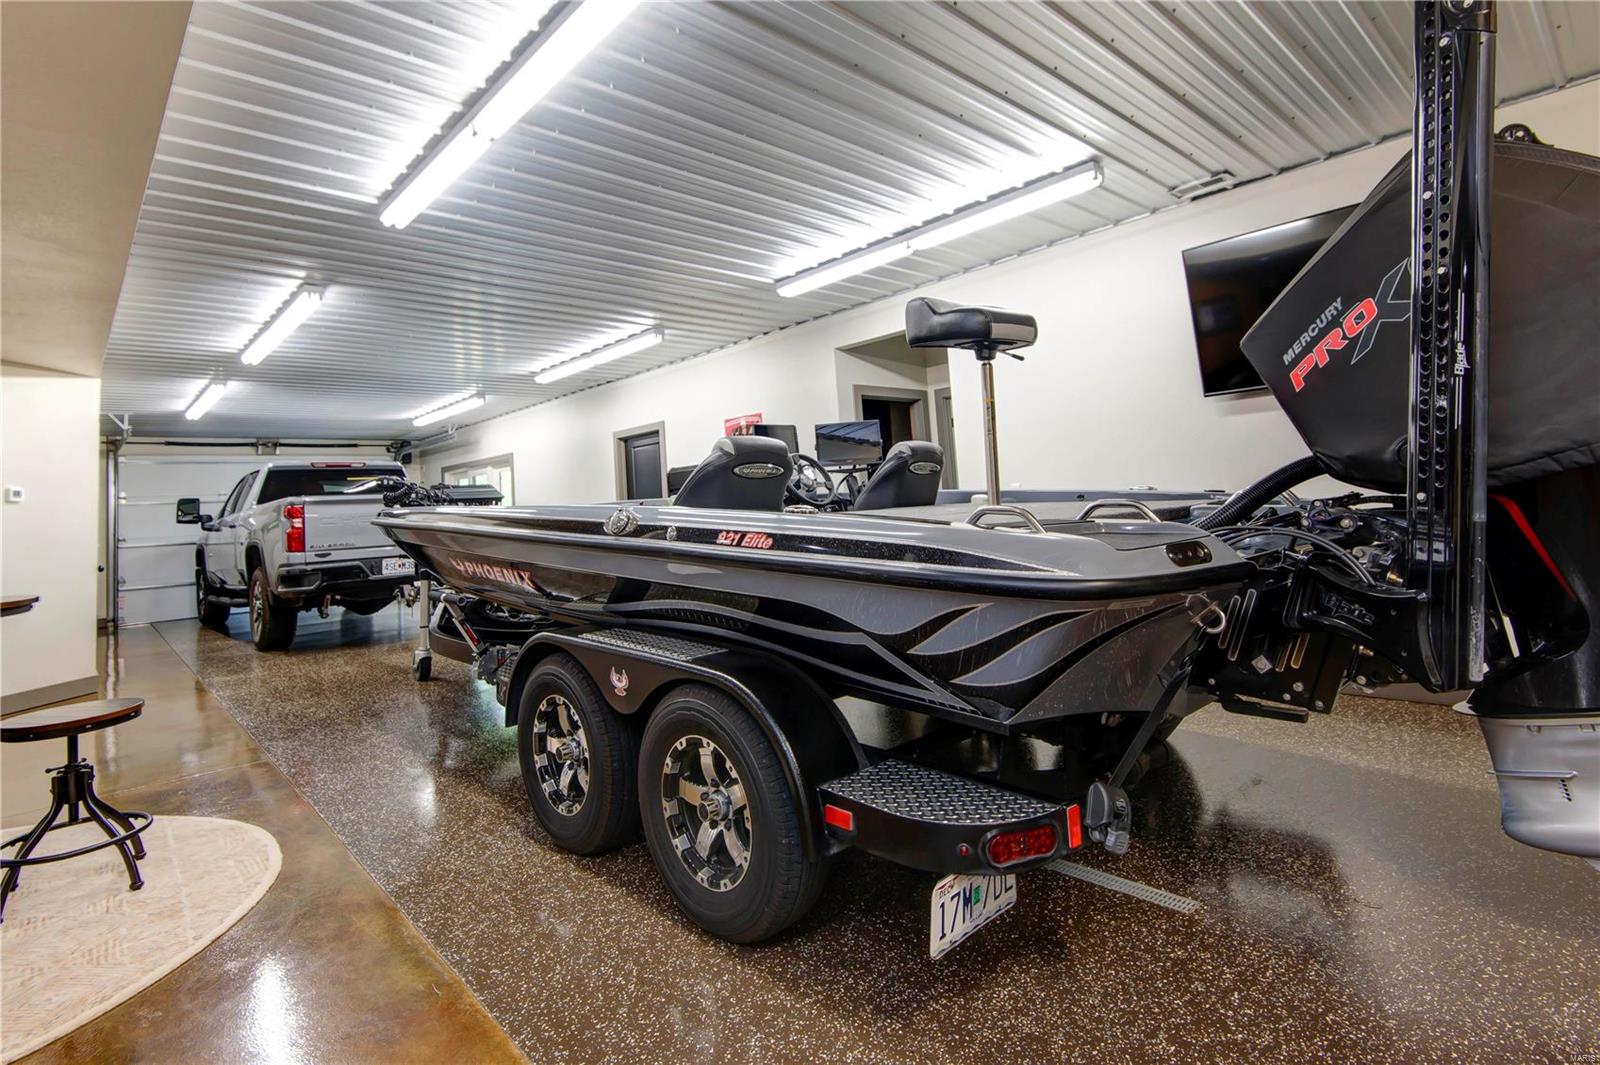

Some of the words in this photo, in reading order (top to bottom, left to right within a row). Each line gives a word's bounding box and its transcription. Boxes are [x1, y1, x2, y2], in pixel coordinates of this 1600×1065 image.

[1282, 296, 1343, 365] MERCURY
[1289, 297, 1378, 393] PRO
[1454, 342, 1468, 375] Blade
[715, 531, 743, 546] 921
[740, 533, 774, 549] Elite
[464, 561, 535, 587] PHOENIX
[939, 881, 973, 942] 17M
